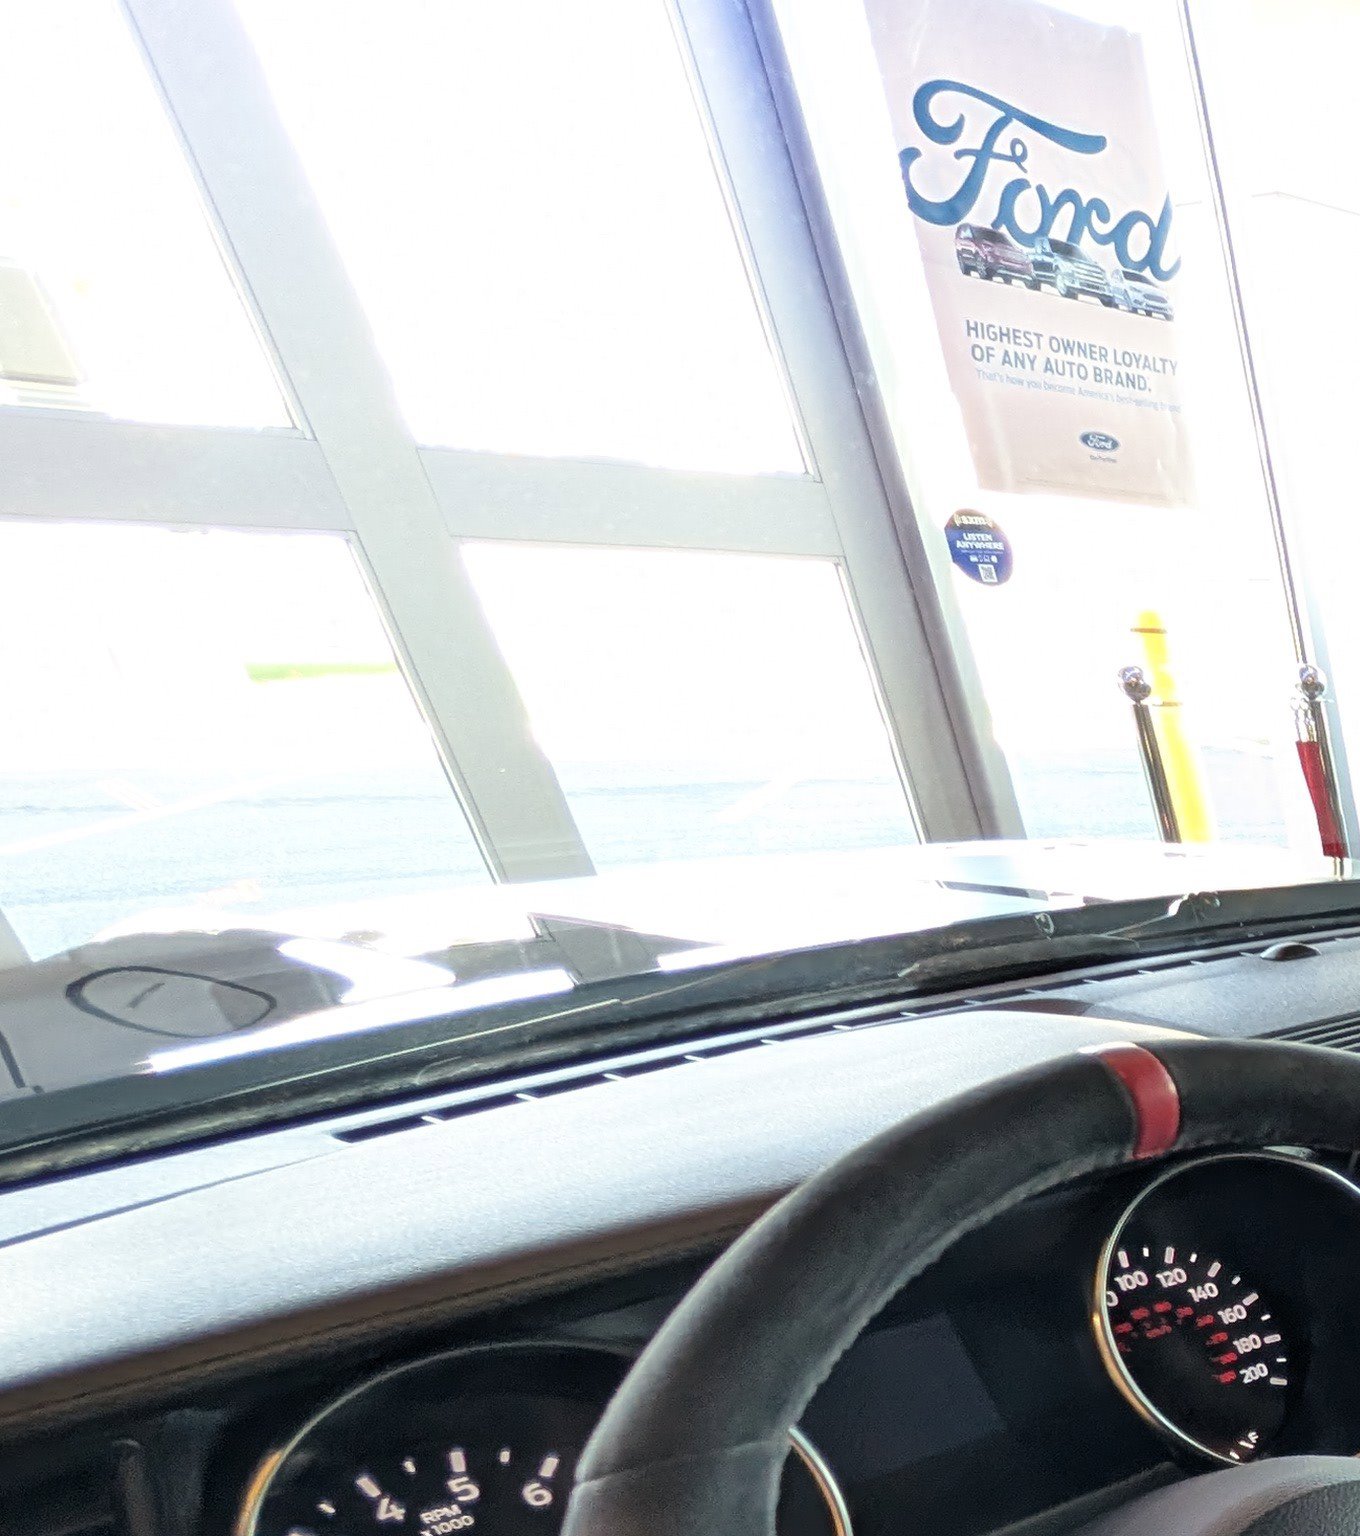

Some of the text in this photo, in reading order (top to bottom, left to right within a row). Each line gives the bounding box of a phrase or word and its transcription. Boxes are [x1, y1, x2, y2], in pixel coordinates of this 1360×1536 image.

[898, 79, 1181, 282] Ford
[966, 319, 1178, 376] HIGHEST OWNER LOYALTY
[971, 343, 996, 363] OF
[1001, 349, 1037, 373] ANY
[1043, 356, 1088, 381] AUTO
[1114, 1271, 1148, 1291] 100
[1155, 1268, 1187, 1288] 120
[1187, 1283, 1219, 1303] 140
[1217, 1304, 1247, 1325] 160
[1232, 1334, 1262, 1354] 180
[1239, 1363, 1269, 1384] 200
[447, 1476, 481, 1502] 5
[522, 1483, 553, 1507] 6
[377, 1497, 406, 1521] 4
[420, 1505, 462, 1525] RPM
